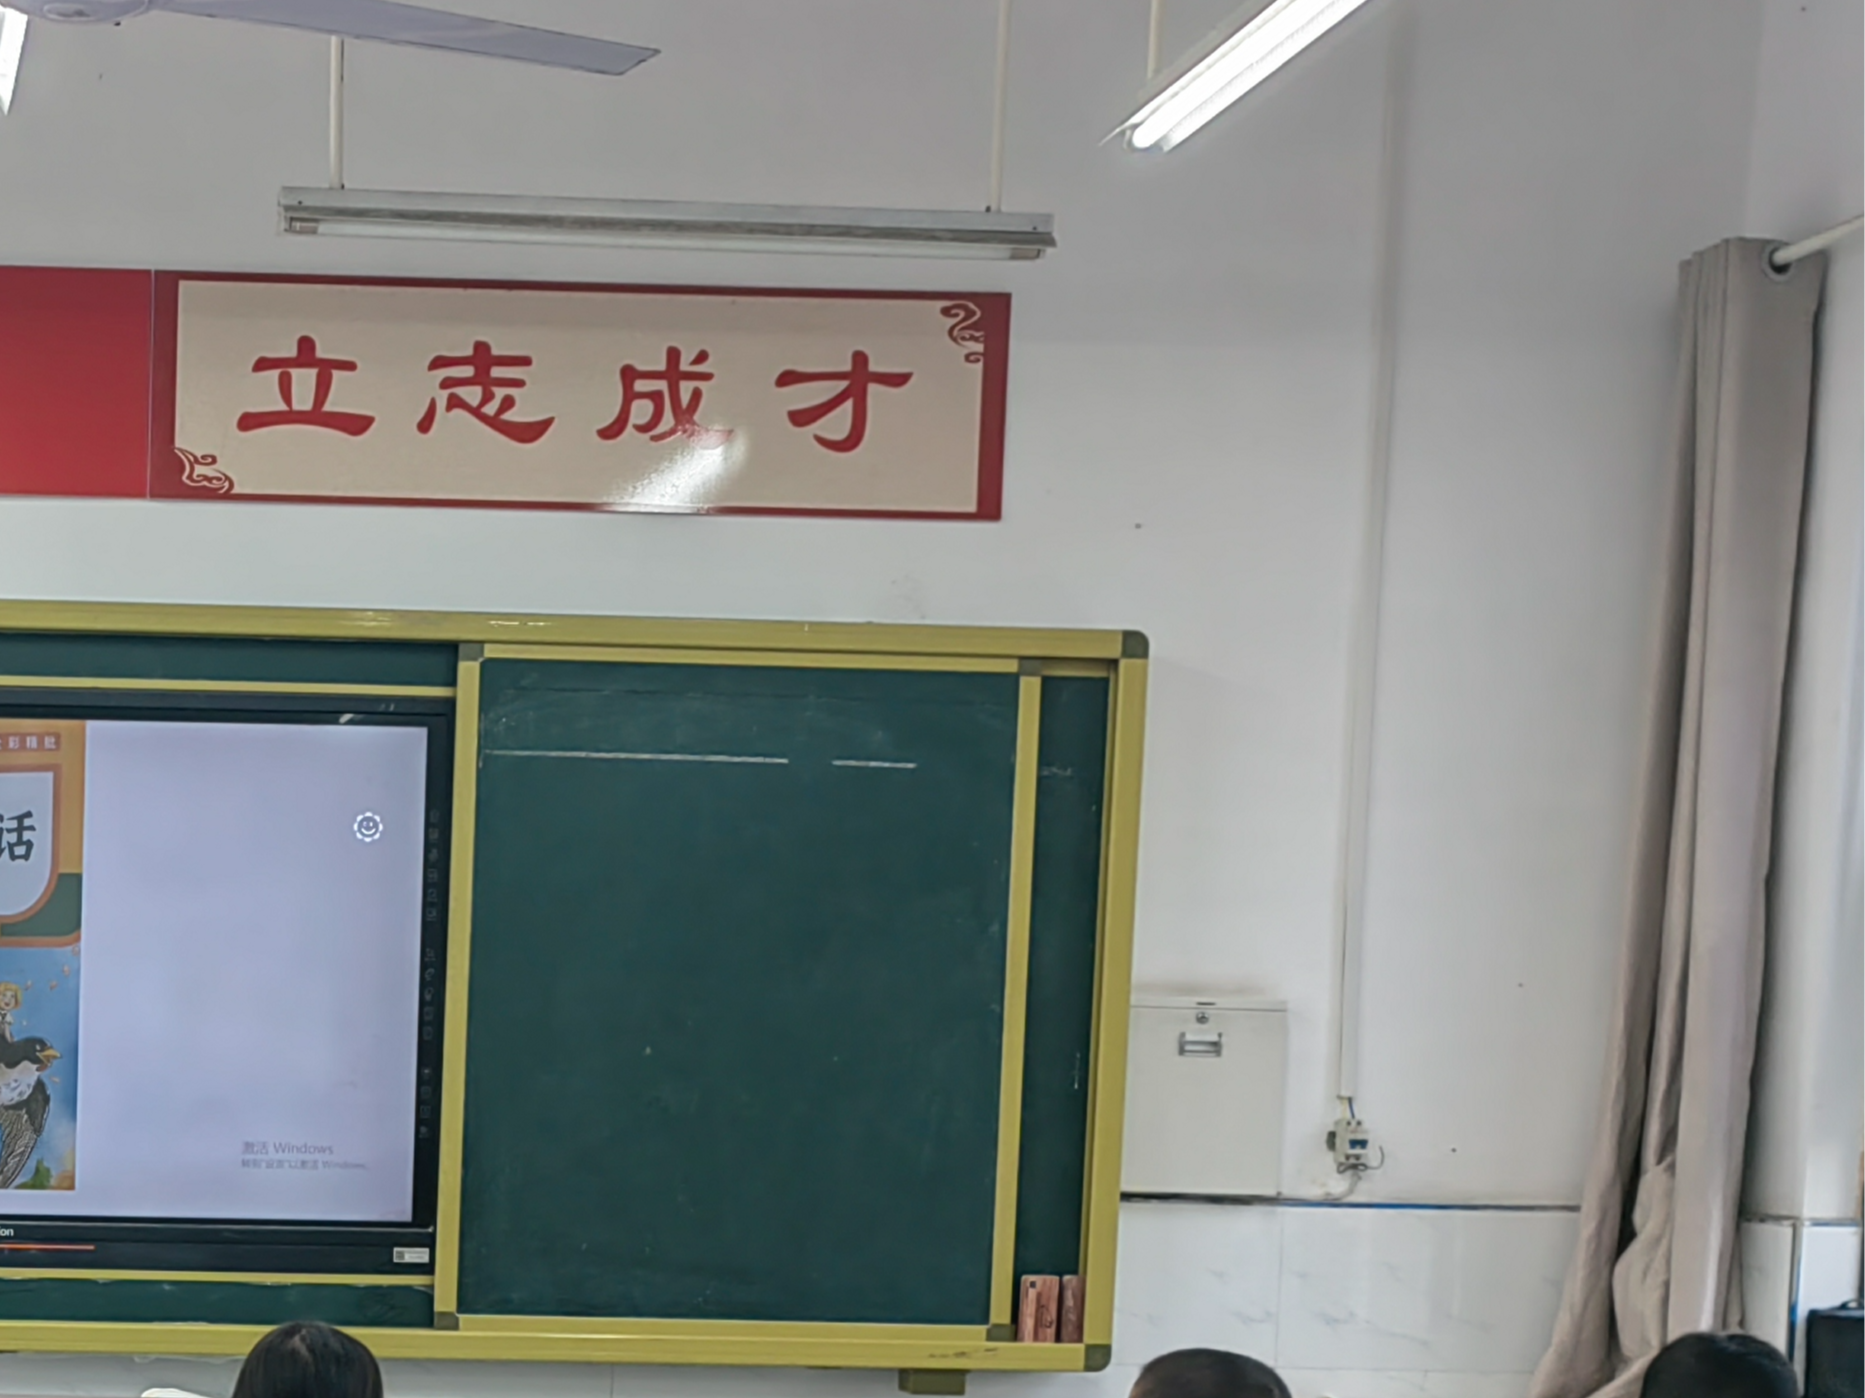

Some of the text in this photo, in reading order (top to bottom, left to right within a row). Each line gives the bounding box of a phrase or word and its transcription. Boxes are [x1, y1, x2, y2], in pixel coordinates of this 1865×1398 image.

[236, 335, 915, 453] 立志成才
[273, 1141, 334, 1156] Windows
